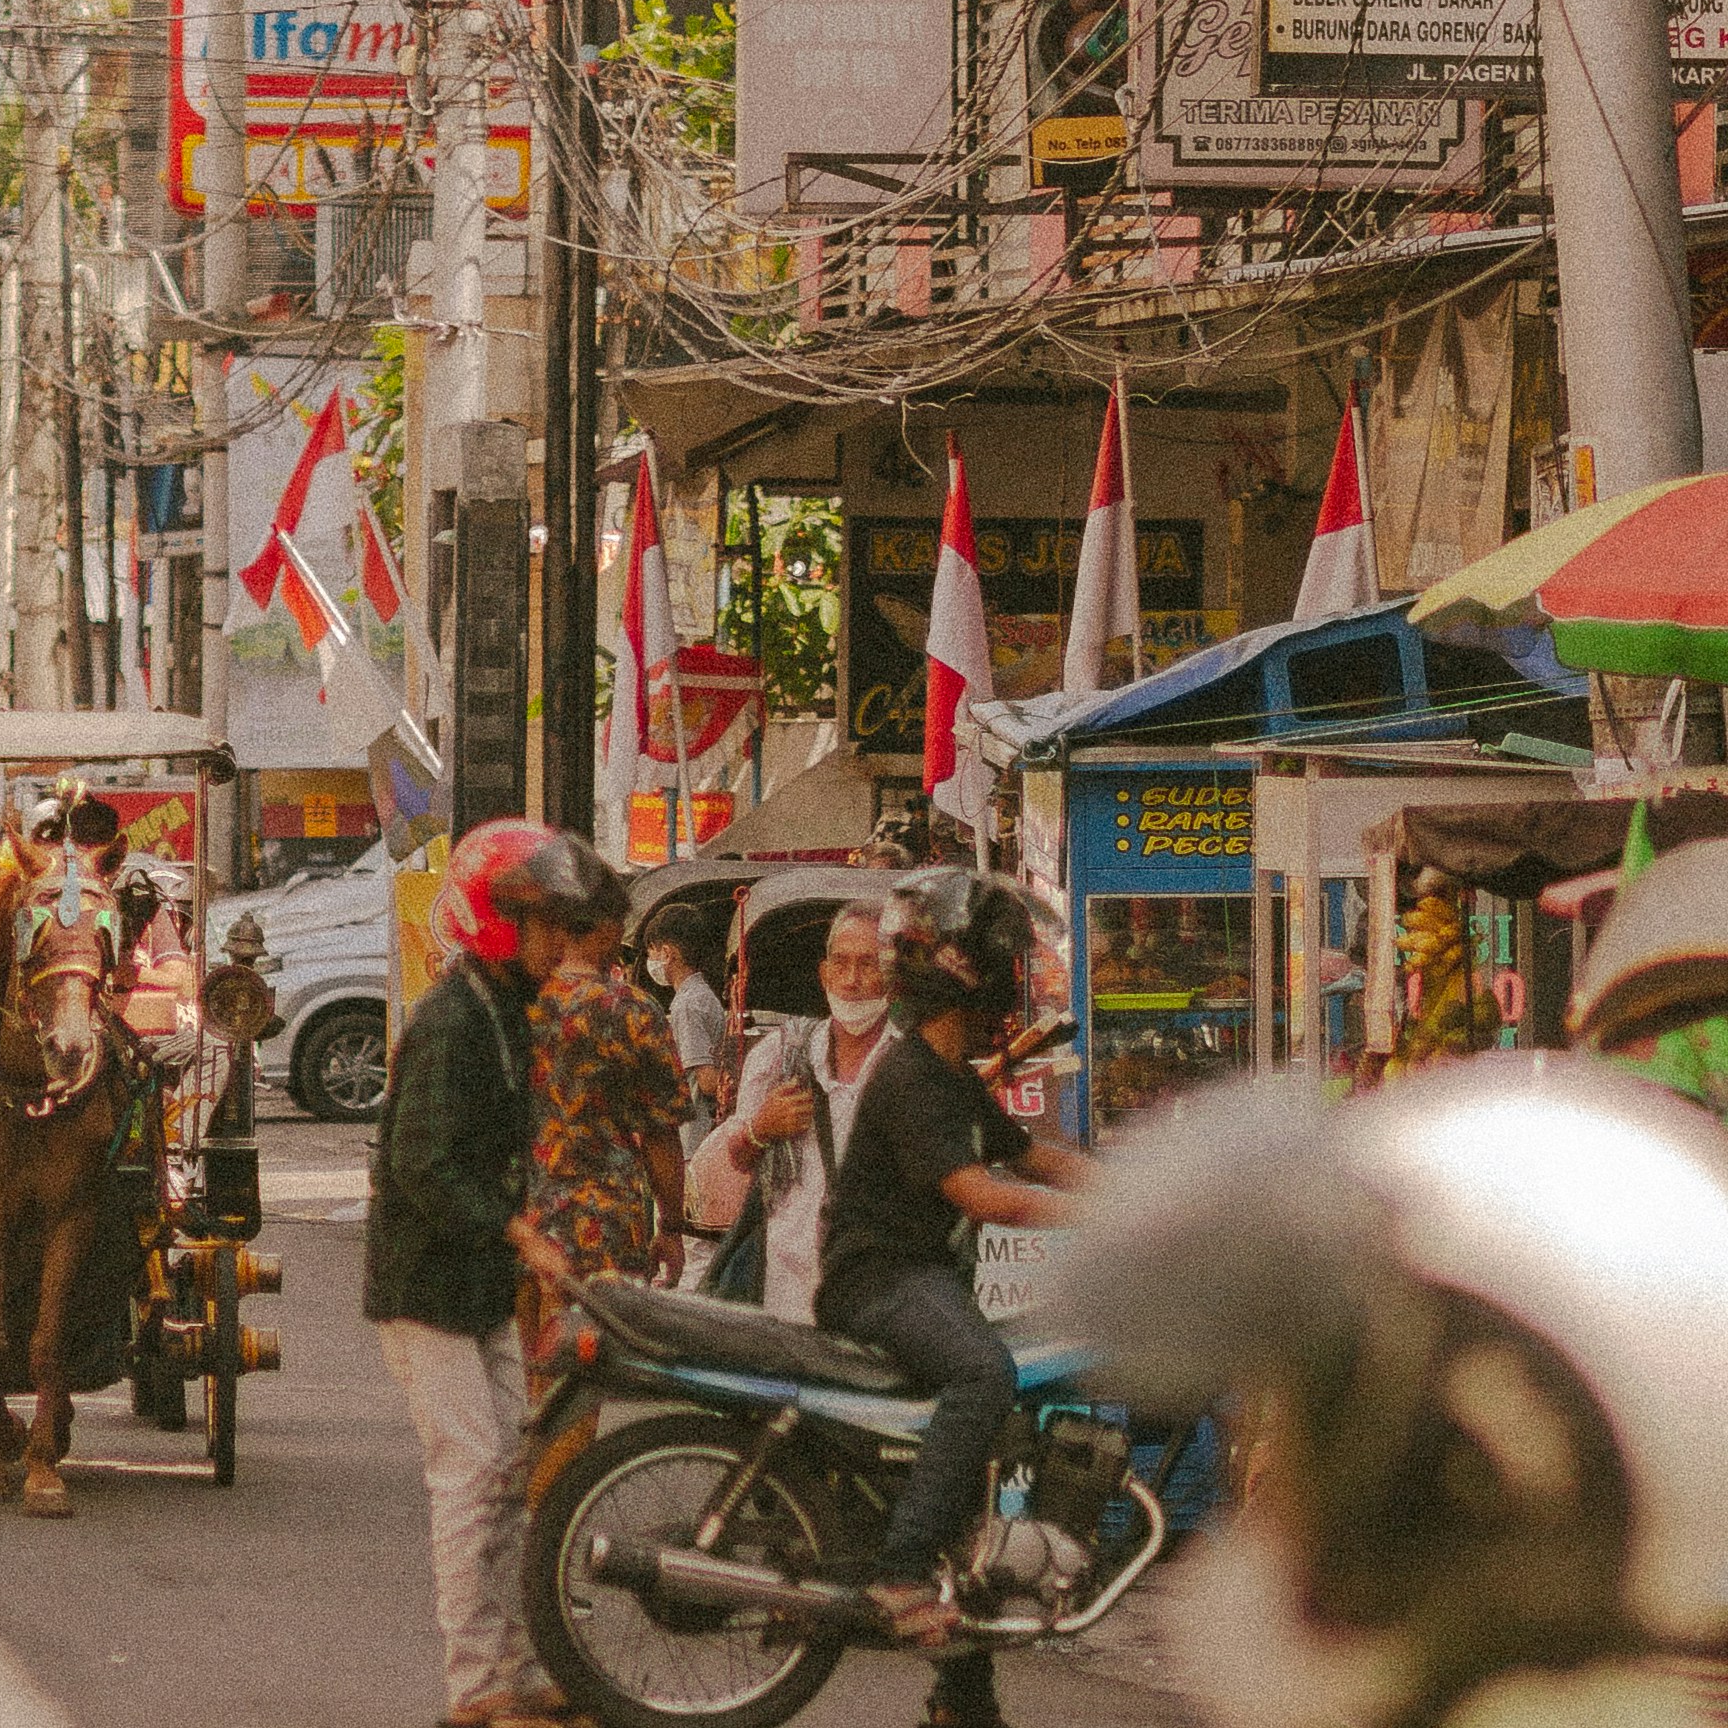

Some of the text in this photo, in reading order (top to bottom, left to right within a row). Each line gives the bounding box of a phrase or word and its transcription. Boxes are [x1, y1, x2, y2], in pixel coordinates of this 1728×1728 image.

[1366, 20, 1412, 42] DARA
[1417, 21, 1488, 43] GORENG
[1406, 63, 1438, 81] JL.
[1443, 64, 1521, 83] DAGEN
[1179, 97, 1442, 127] TERIMA PESANAN
[1138, 810, 1252, 832] RAME
[1142, 835, 1252, 857] PECE
